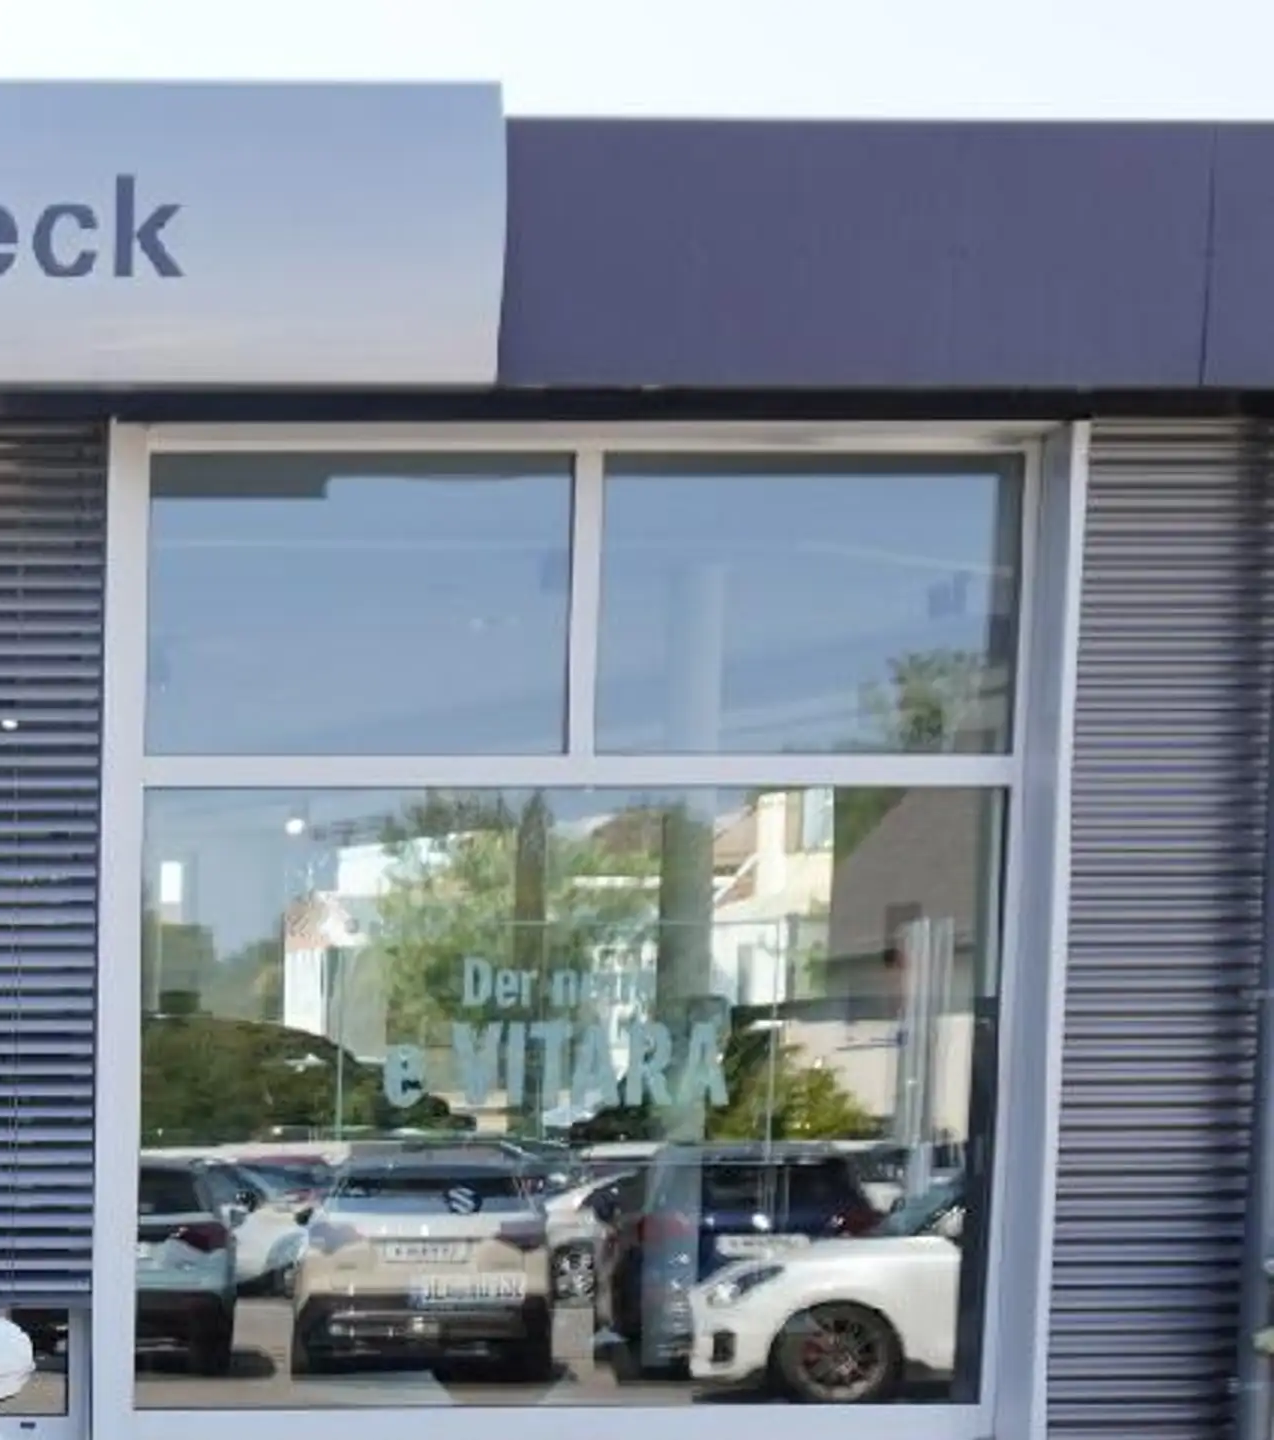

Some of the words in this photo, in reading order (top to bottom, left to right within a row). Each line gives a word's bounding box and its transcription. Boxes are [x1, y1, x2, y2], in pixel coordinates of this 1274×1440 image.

[462, 956, 539, 1007] Der
[383, 1042, 428, 1109] e
[452, 1019, 730, 1108] VITARA
